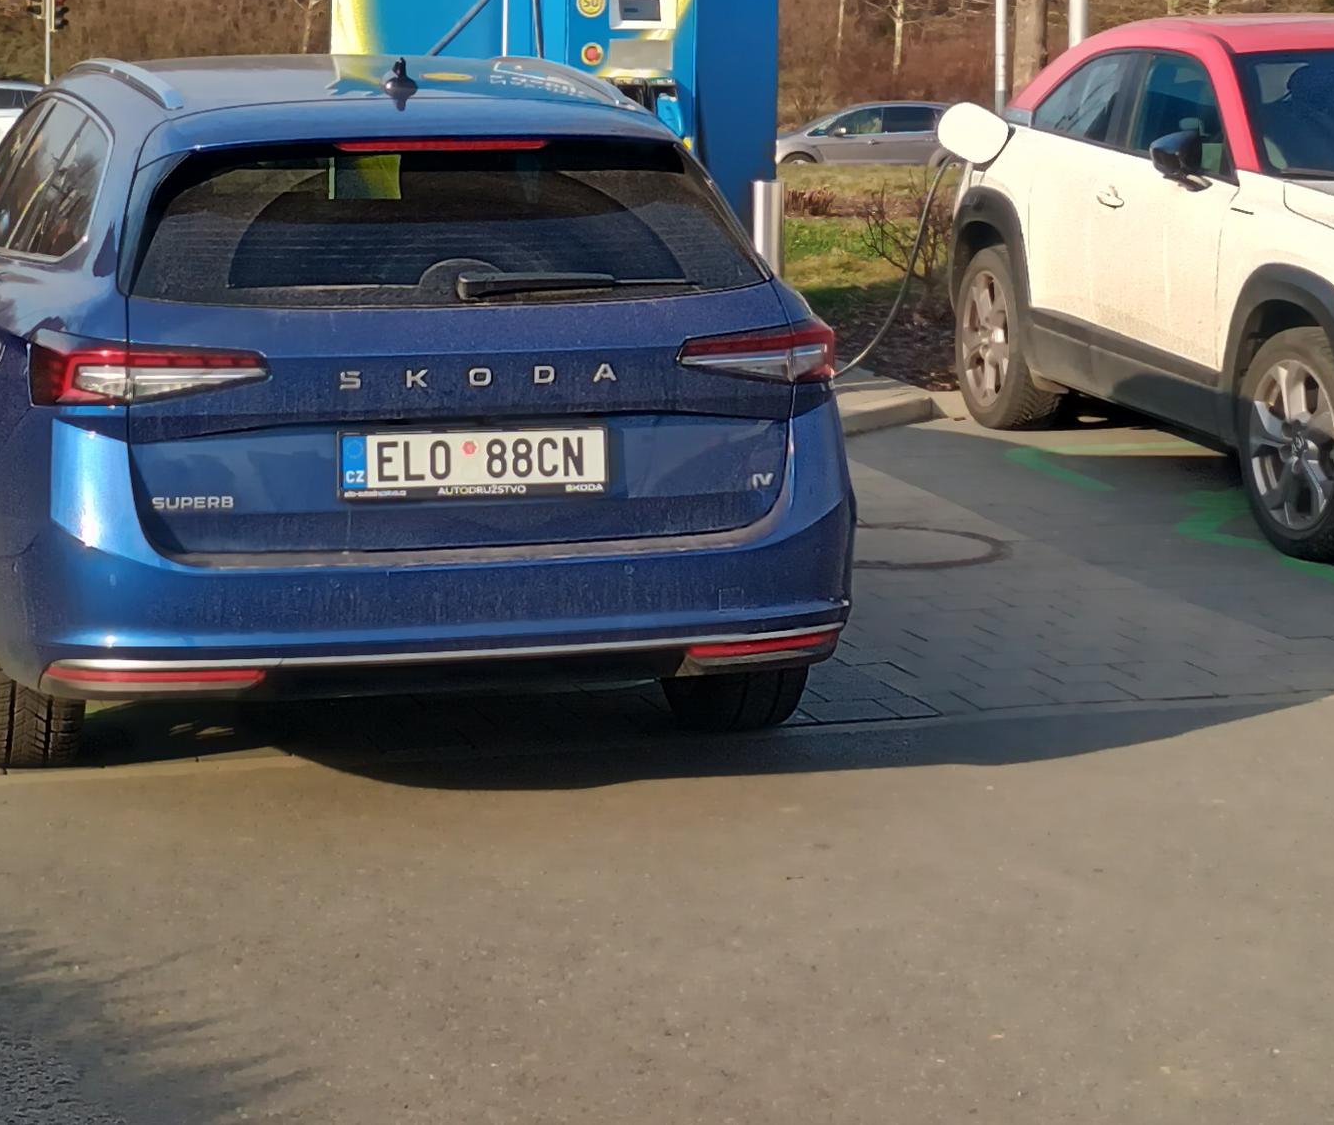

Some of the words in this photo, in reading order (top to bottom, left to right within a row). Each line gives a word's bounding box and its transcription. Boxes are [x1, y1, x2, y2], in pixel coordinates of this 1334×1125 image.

[486, 436, 585, 479] 88CN
[344, 470, 365, 484] CZ
[437, 483, 527, 496] AUTODRUŽSTVO
[151, 496, 235, 510] SUPERB
